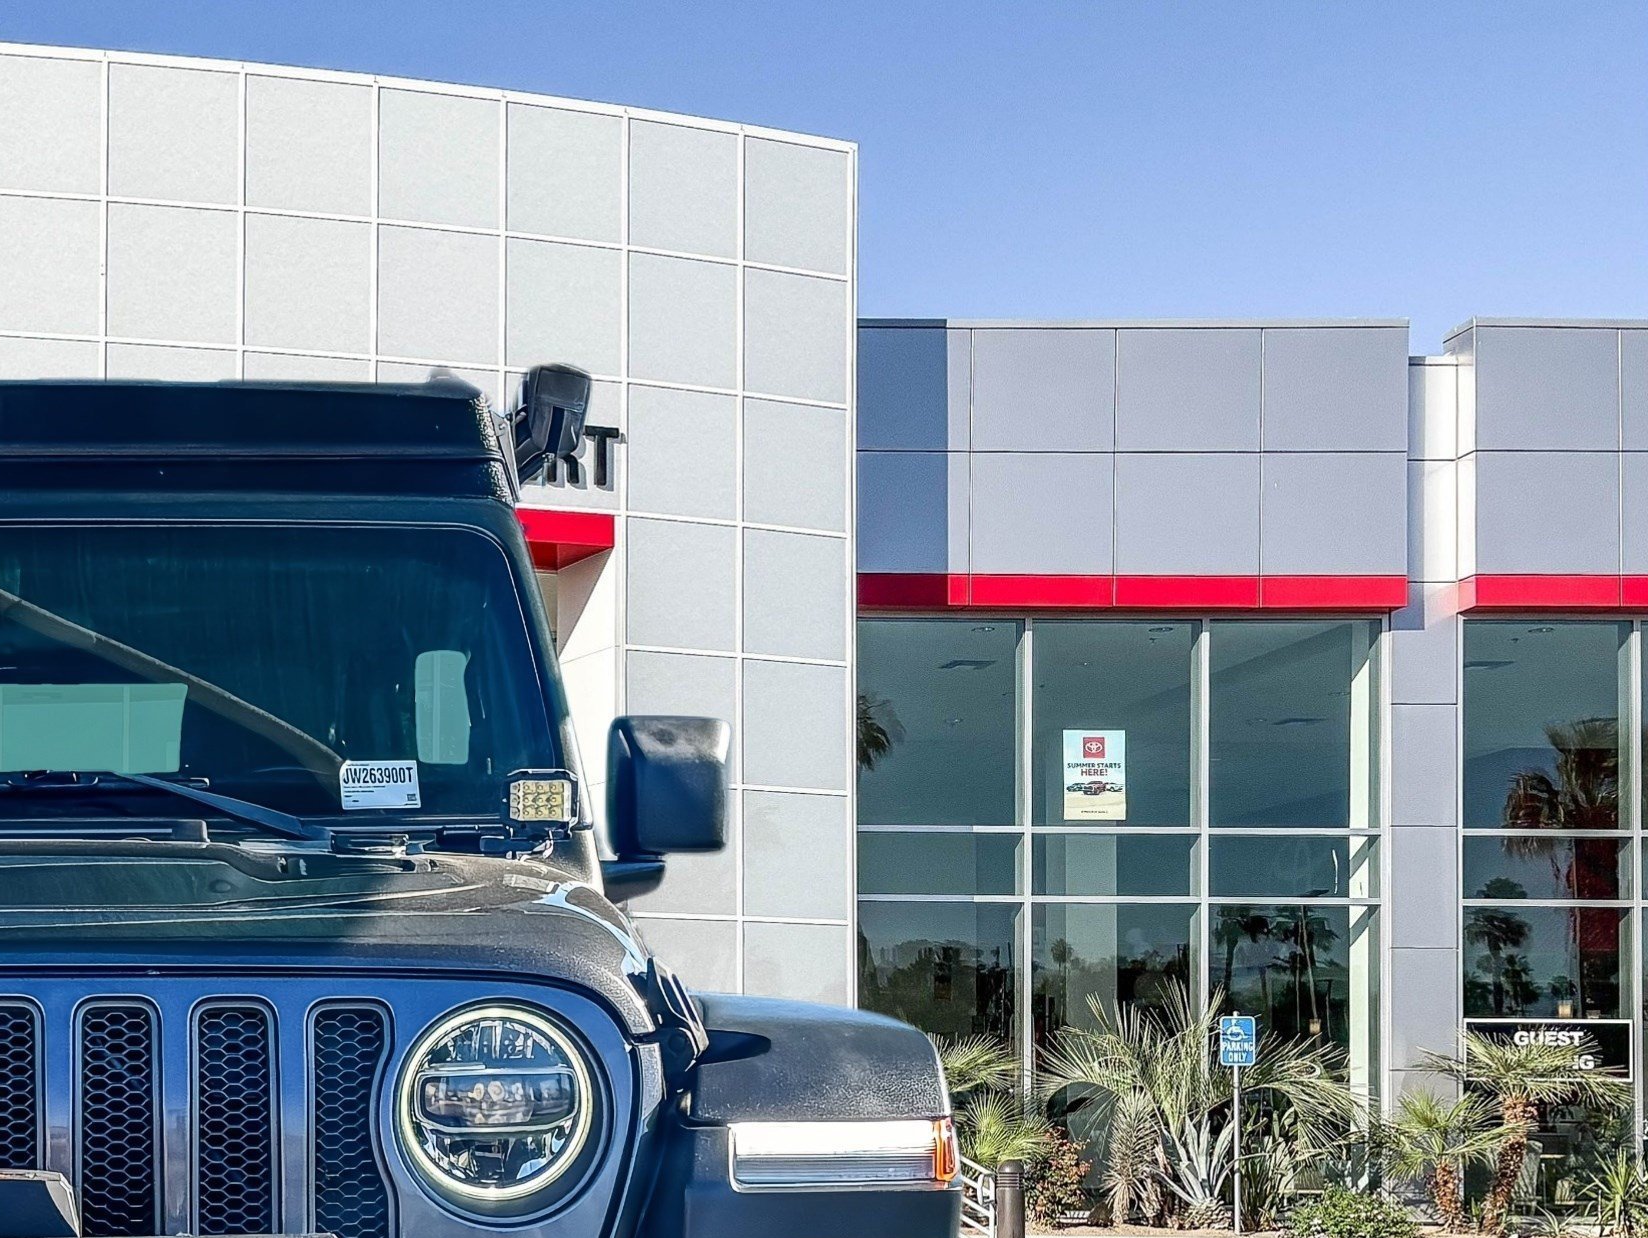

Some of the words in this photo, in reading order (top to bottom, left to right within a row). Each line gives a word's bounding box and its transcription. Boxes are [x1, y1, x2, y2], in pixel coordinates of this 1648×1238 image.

[343, 767, 413, 784] JW263900T
[1513, 1031, 1584, 1046] GUEST
[1223, 1042, 1253, 1051] PARKING
[1228, 1053, 1247, 1062] ONLY
